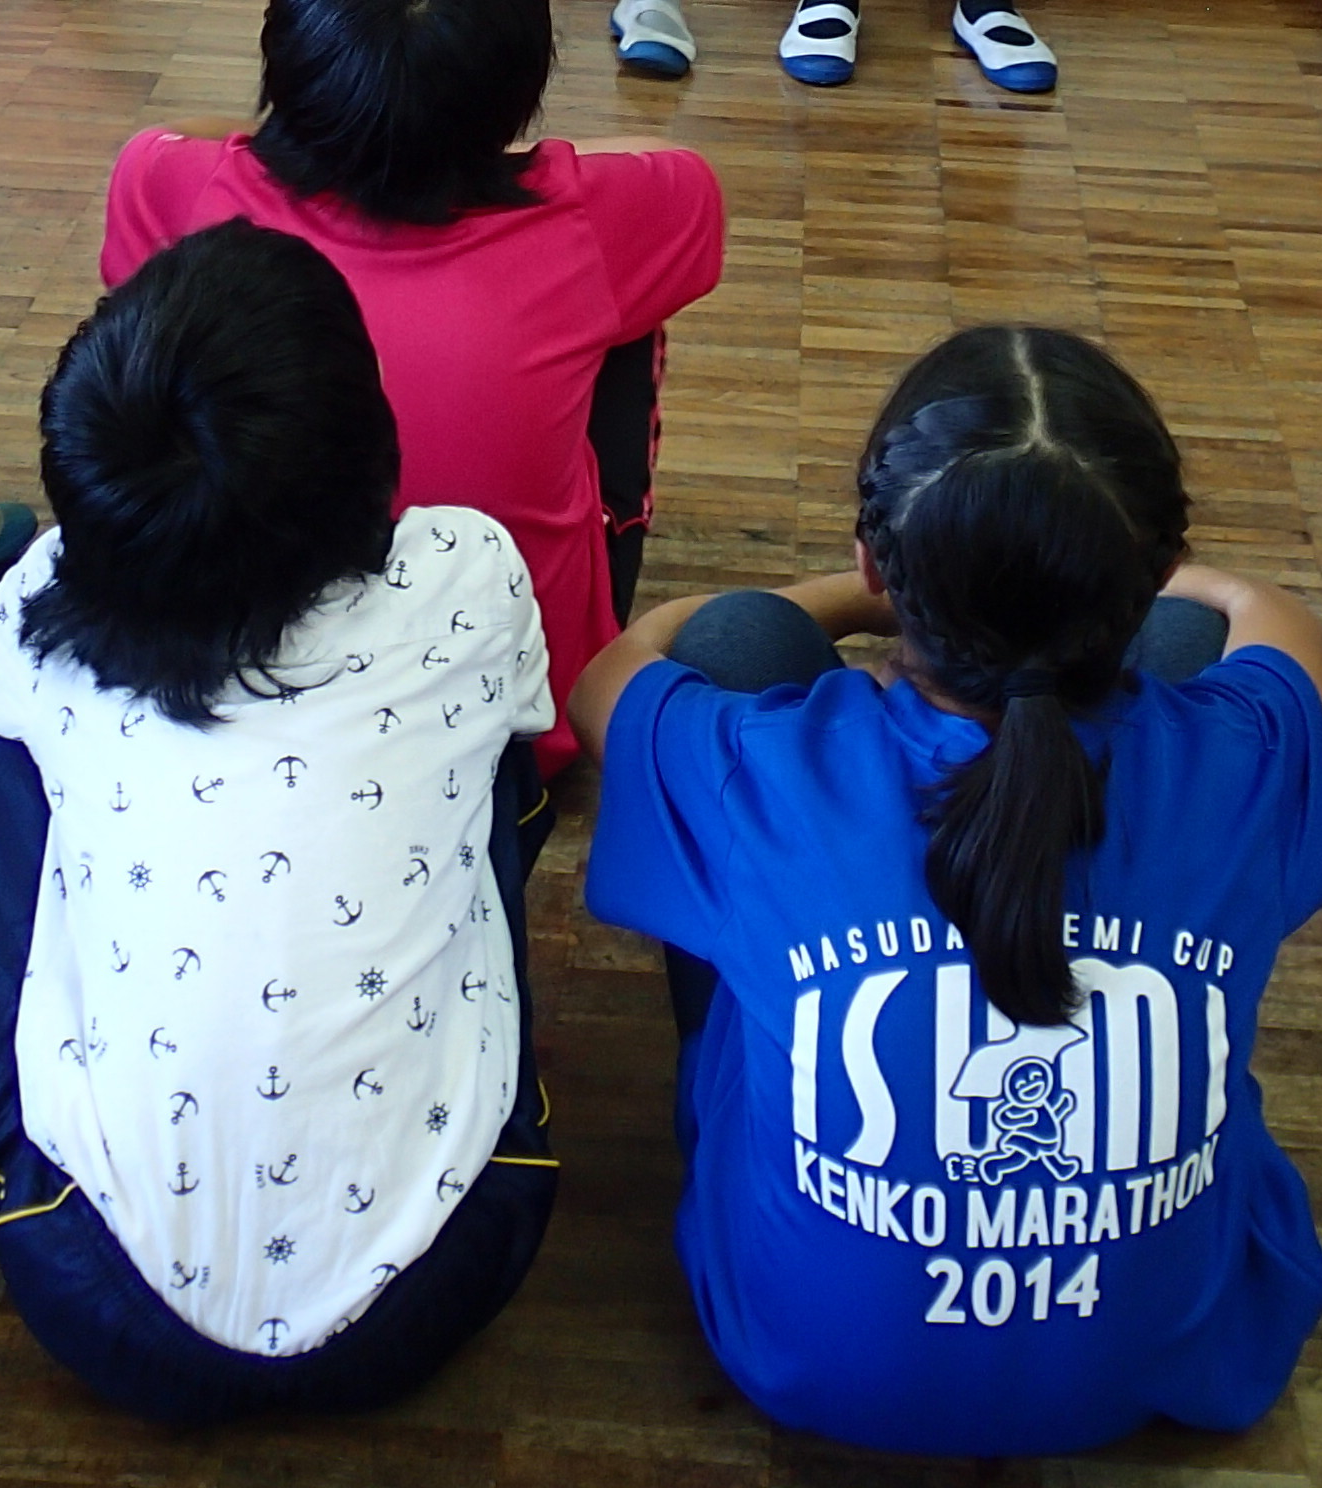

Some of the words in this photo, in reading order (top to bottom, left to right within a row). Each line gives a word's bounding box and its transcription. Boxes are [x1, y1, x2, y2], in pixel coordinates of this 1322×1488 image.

[789, 915, 965, 982] MASUDA
[1062, 913, 1144, 955] EMI
[1174, 928, 1236, 978] CUP
[793, 1139, 947, 1247] KENKO
[966, 1134, 1221, 1249] MARATHON
[924, 1253, 1101, 1327] 2014
